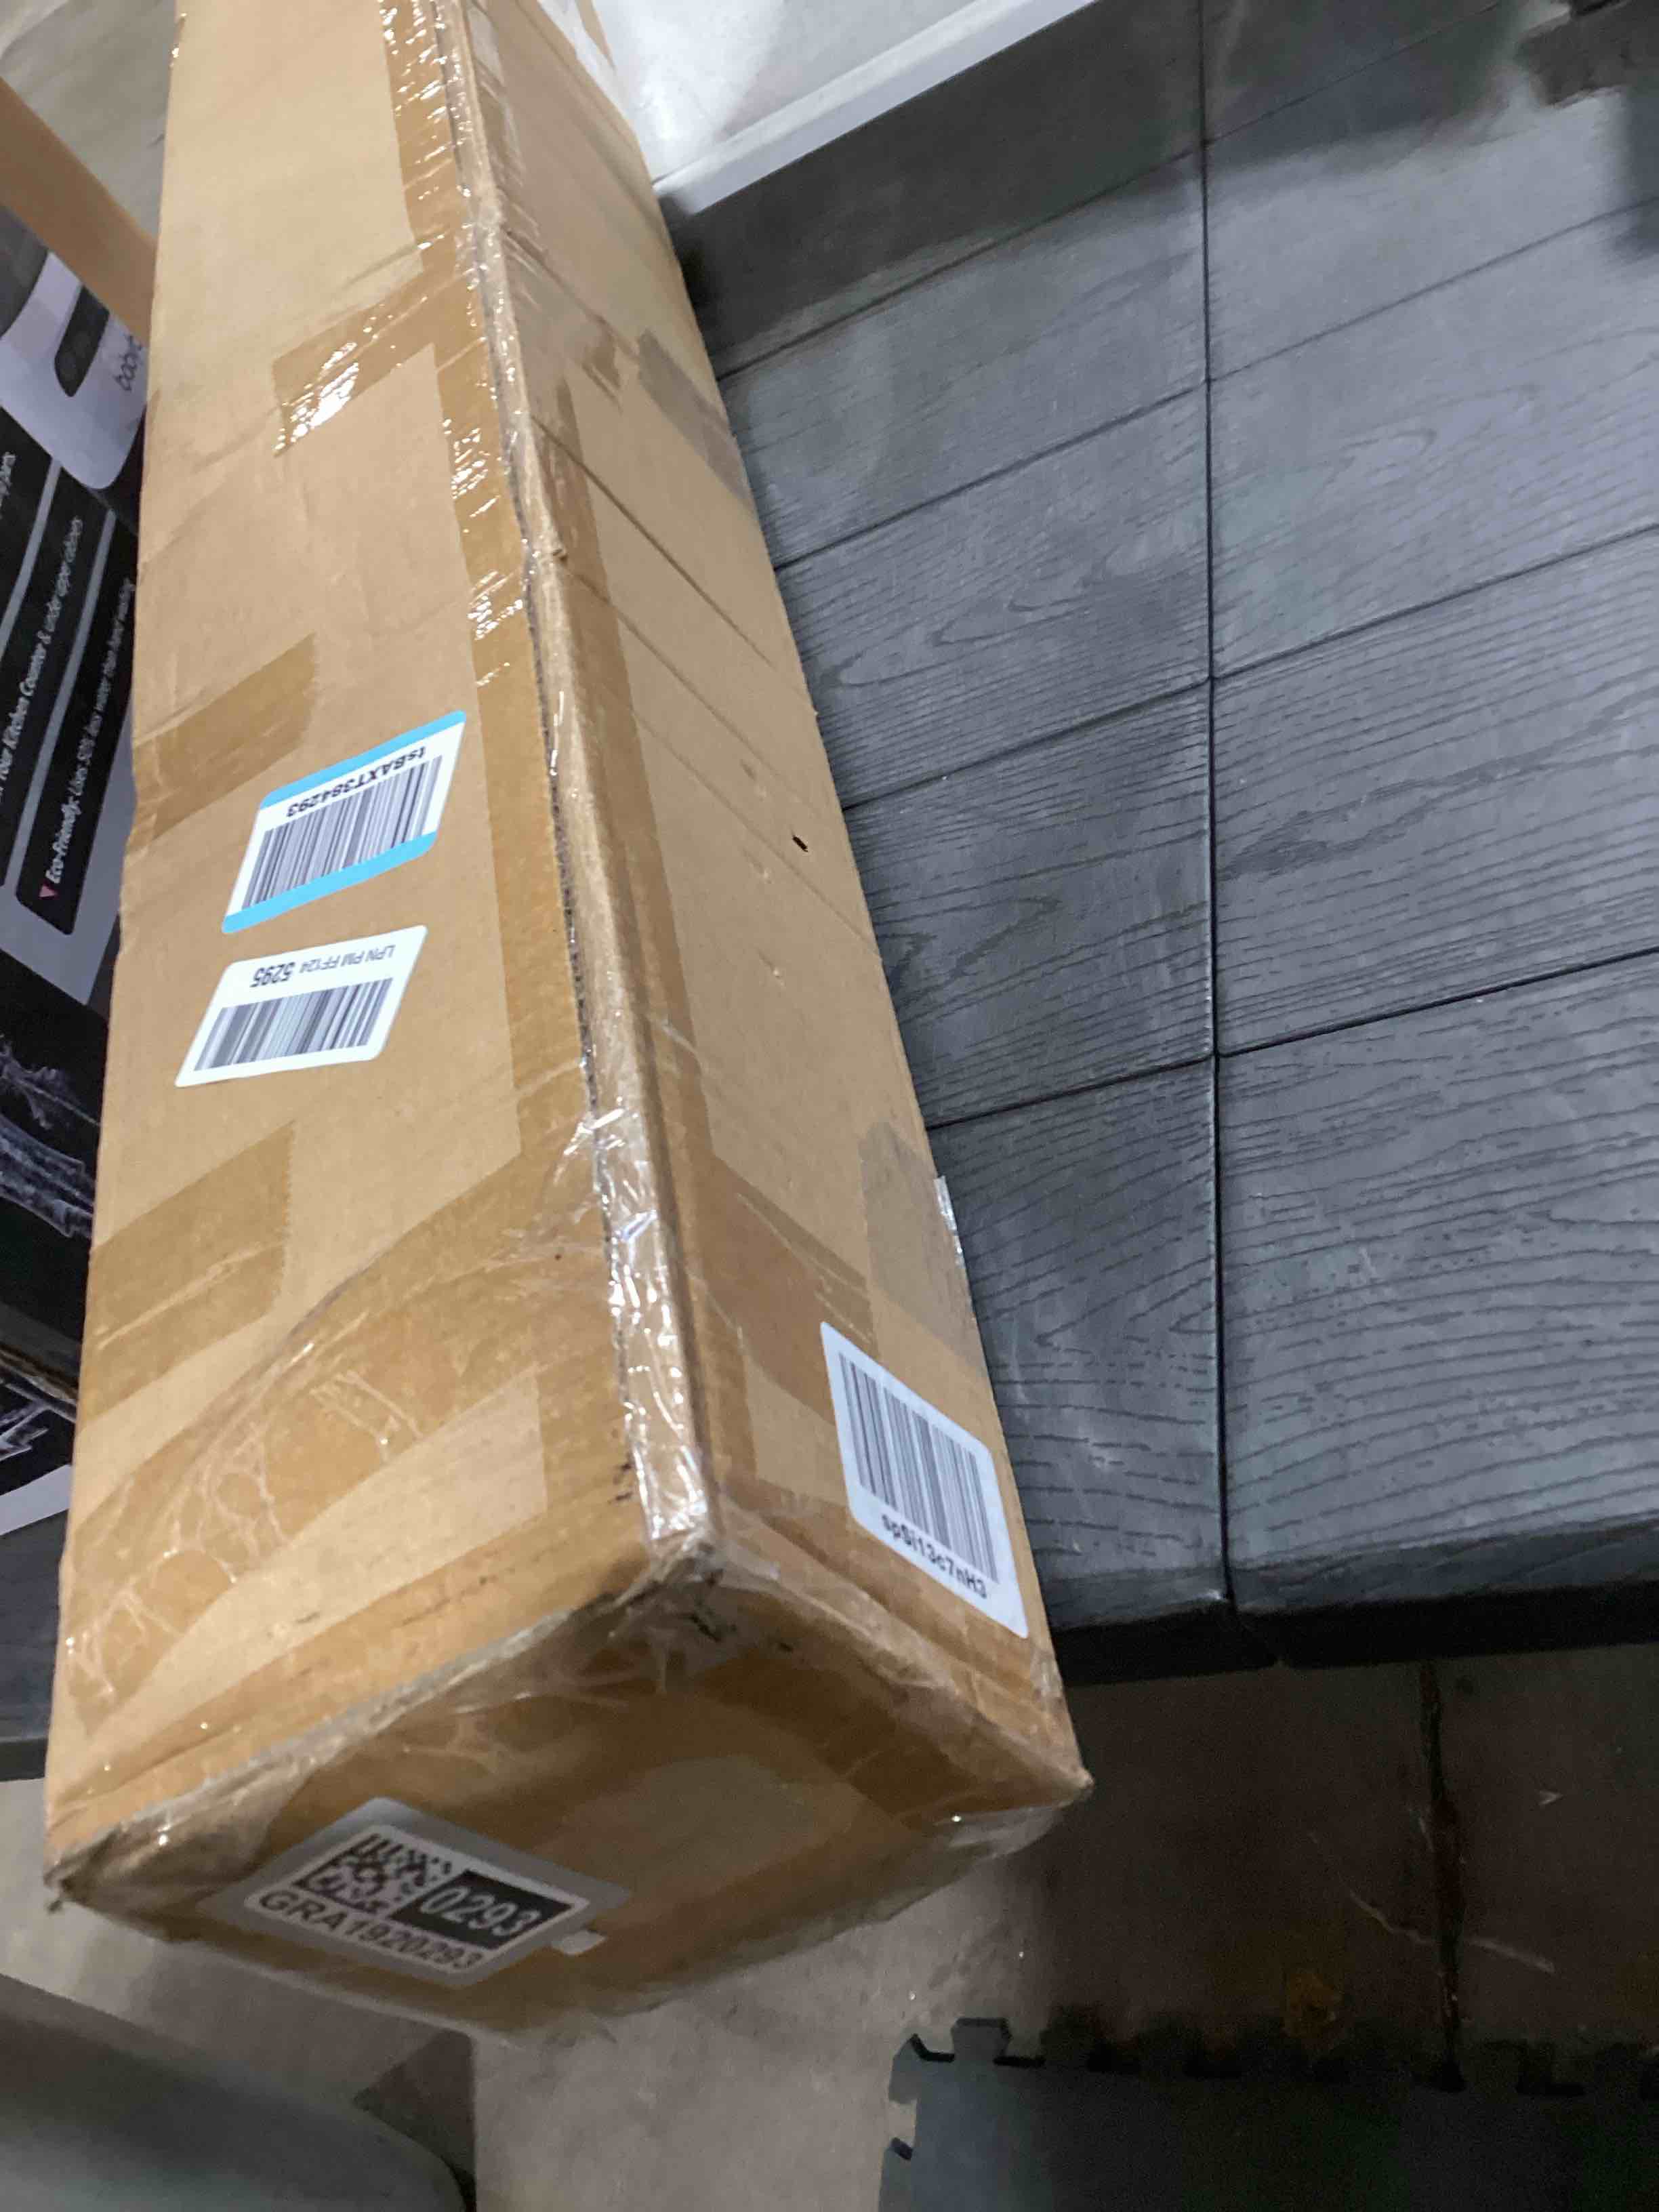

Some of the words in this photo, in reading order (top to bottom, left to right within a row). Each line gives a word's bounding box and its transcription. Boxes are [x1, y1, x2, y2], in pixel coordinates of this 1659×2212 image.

[286, 746, 426, 817] tsBAXT384293
[249, 962, 296, 988] 5295
[258, 1889, 484, 1969] GRA1920293
[419, 1885, 541, 1937] 0293
